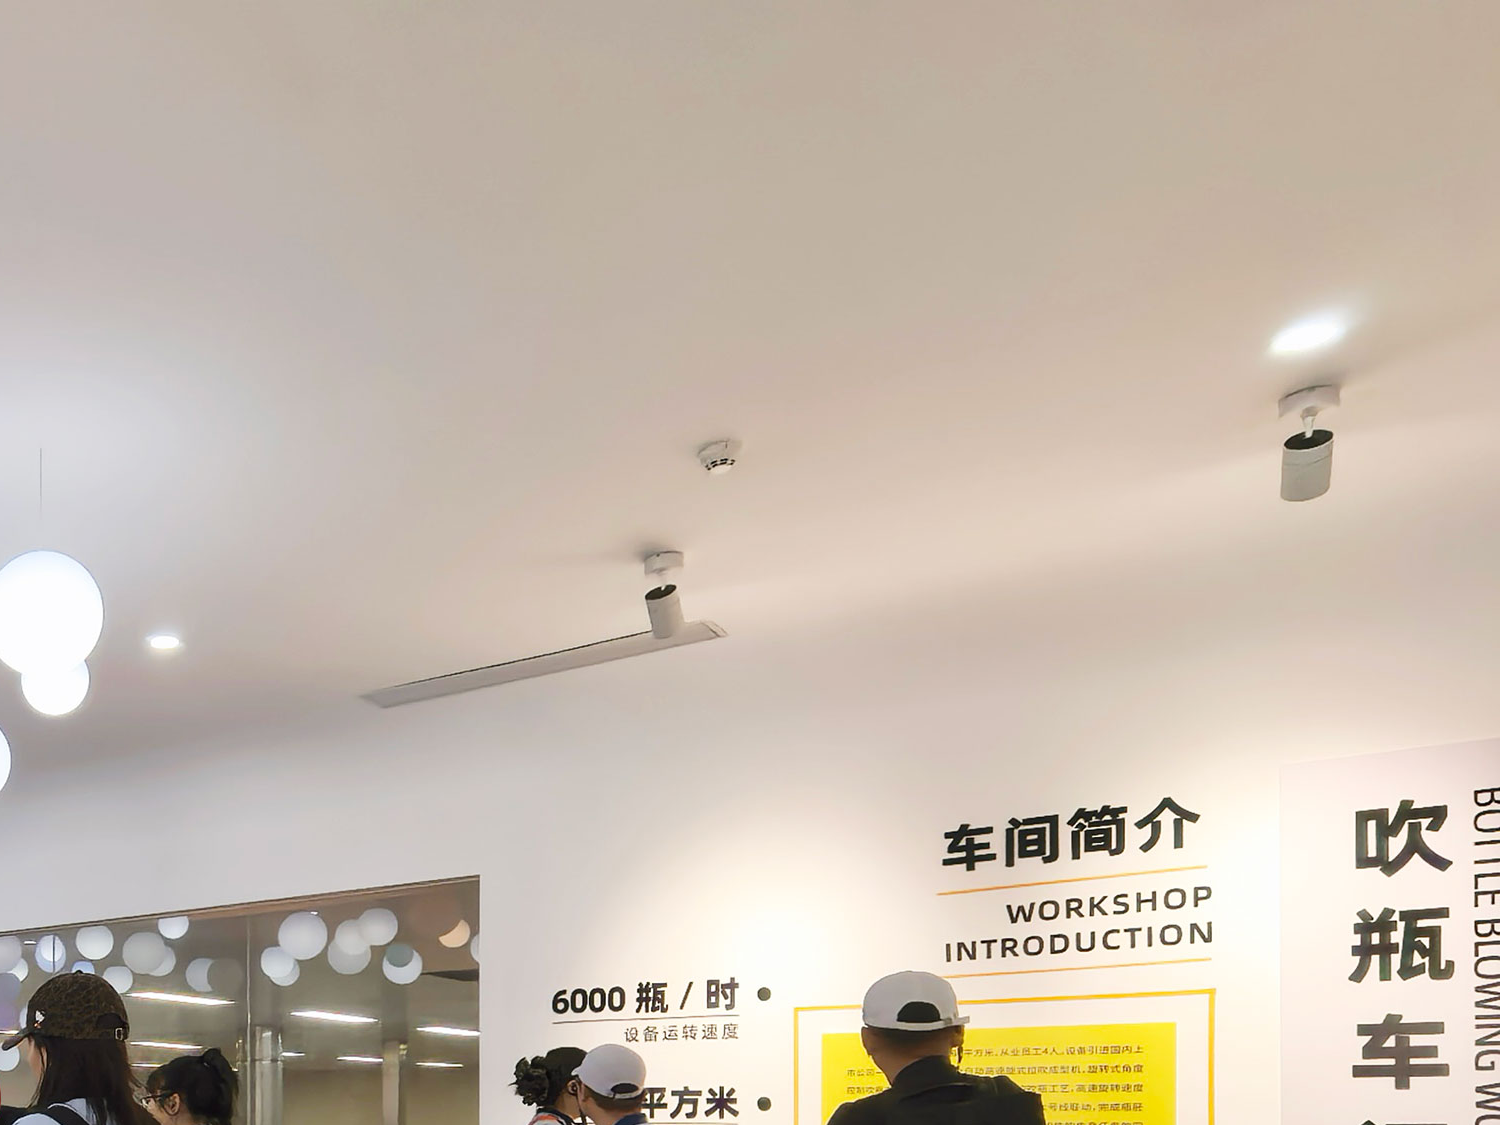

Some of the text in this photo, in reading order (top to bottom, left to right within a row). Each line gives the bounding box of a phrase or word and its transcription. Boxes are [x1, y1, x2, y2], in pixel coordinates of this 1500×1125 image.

[942, 796, 1201, 872] 车间简介
[1006, 886, 1213, 924] WORKSHOP
[945, 921, 1213, 963] INTRODUCTION
[551, 986, 626, 1015] 6000
[635, 981, 669, 1014] 瓶
[706, 976, 739, 1011] 时
[624, 1023, 740, 1044] 设备运转速度
[644, 1086, 739, 1119] 平方米
